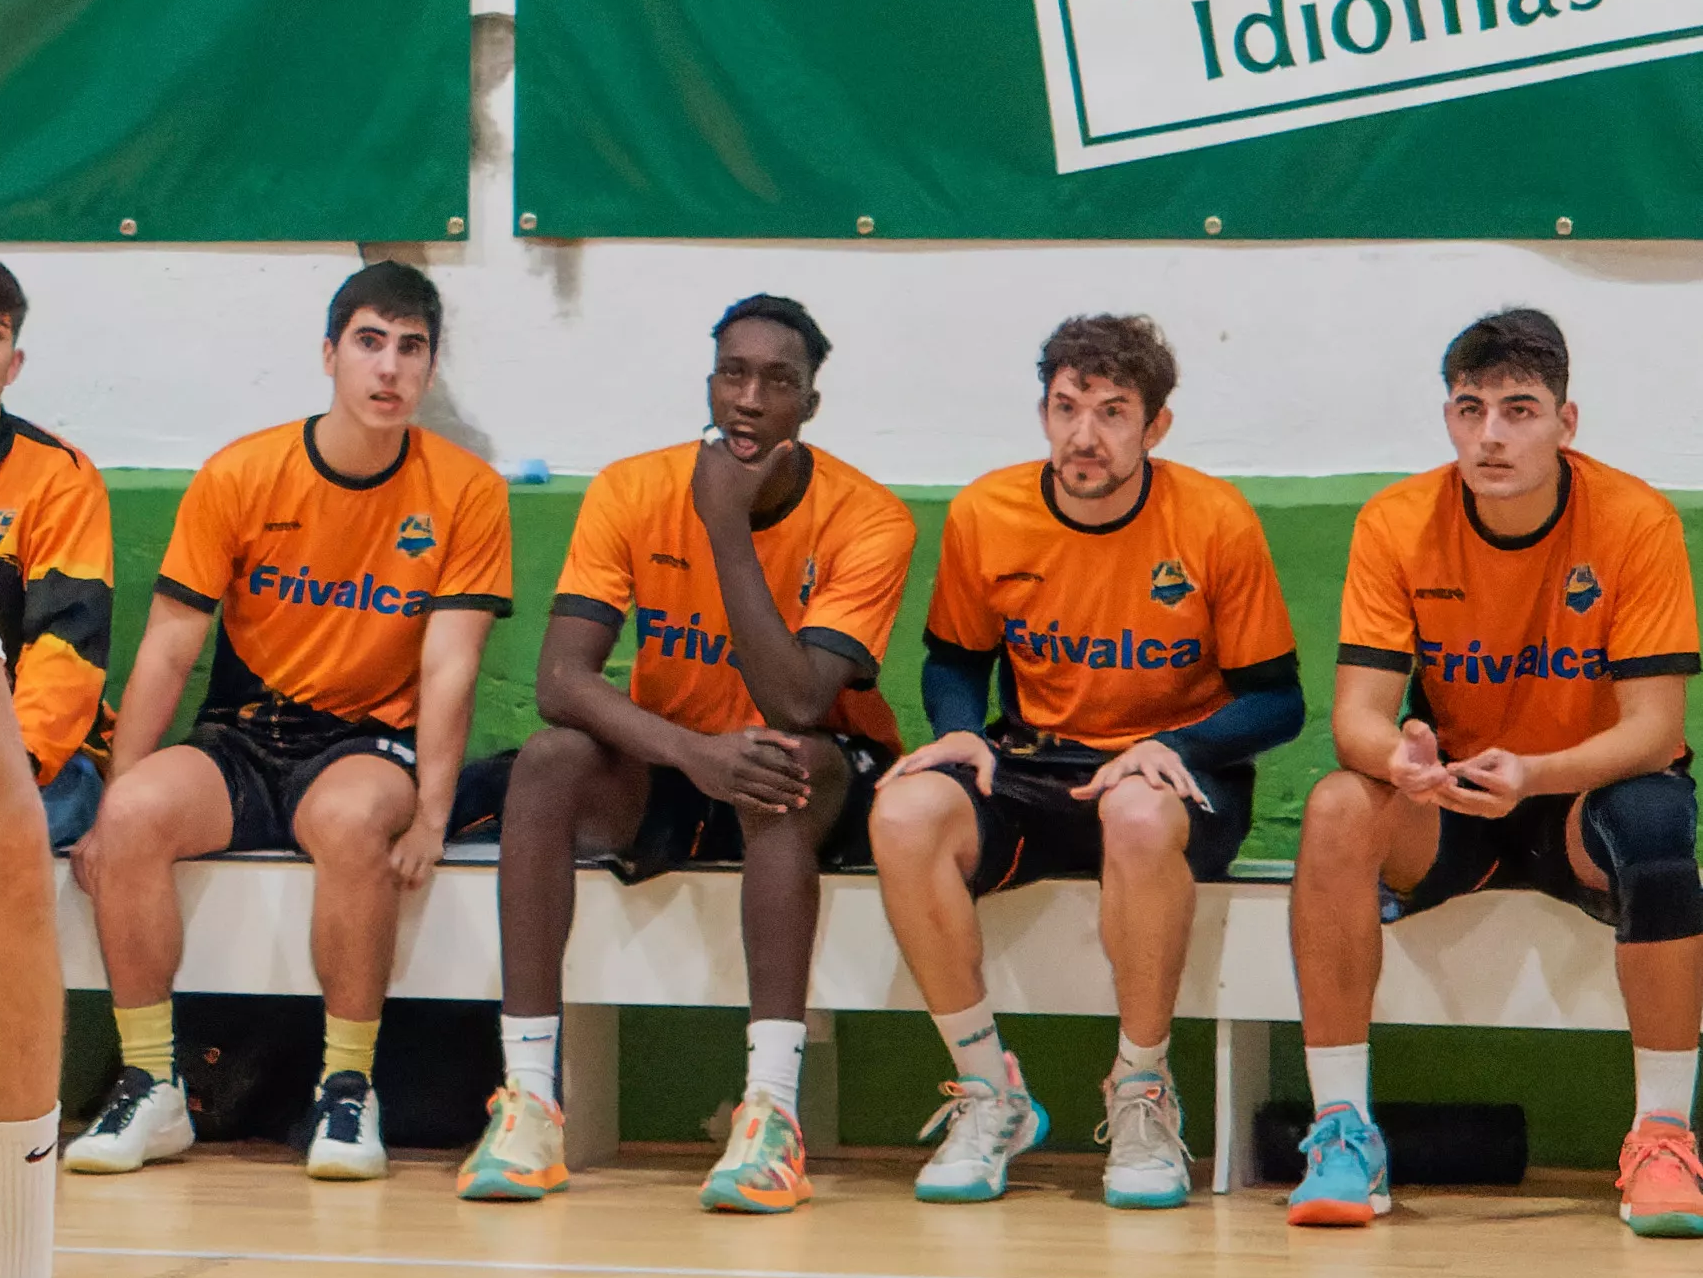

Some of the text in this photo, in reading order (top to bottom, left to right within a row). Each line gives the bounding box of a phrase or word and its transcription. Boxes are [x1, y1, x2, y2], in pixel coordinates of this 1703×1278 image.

[249, 564, 434, 618] Frivalca
[1004, 618, 1202, 670] Frivalca
[1418, 637, 1610, 685] Frivalca
